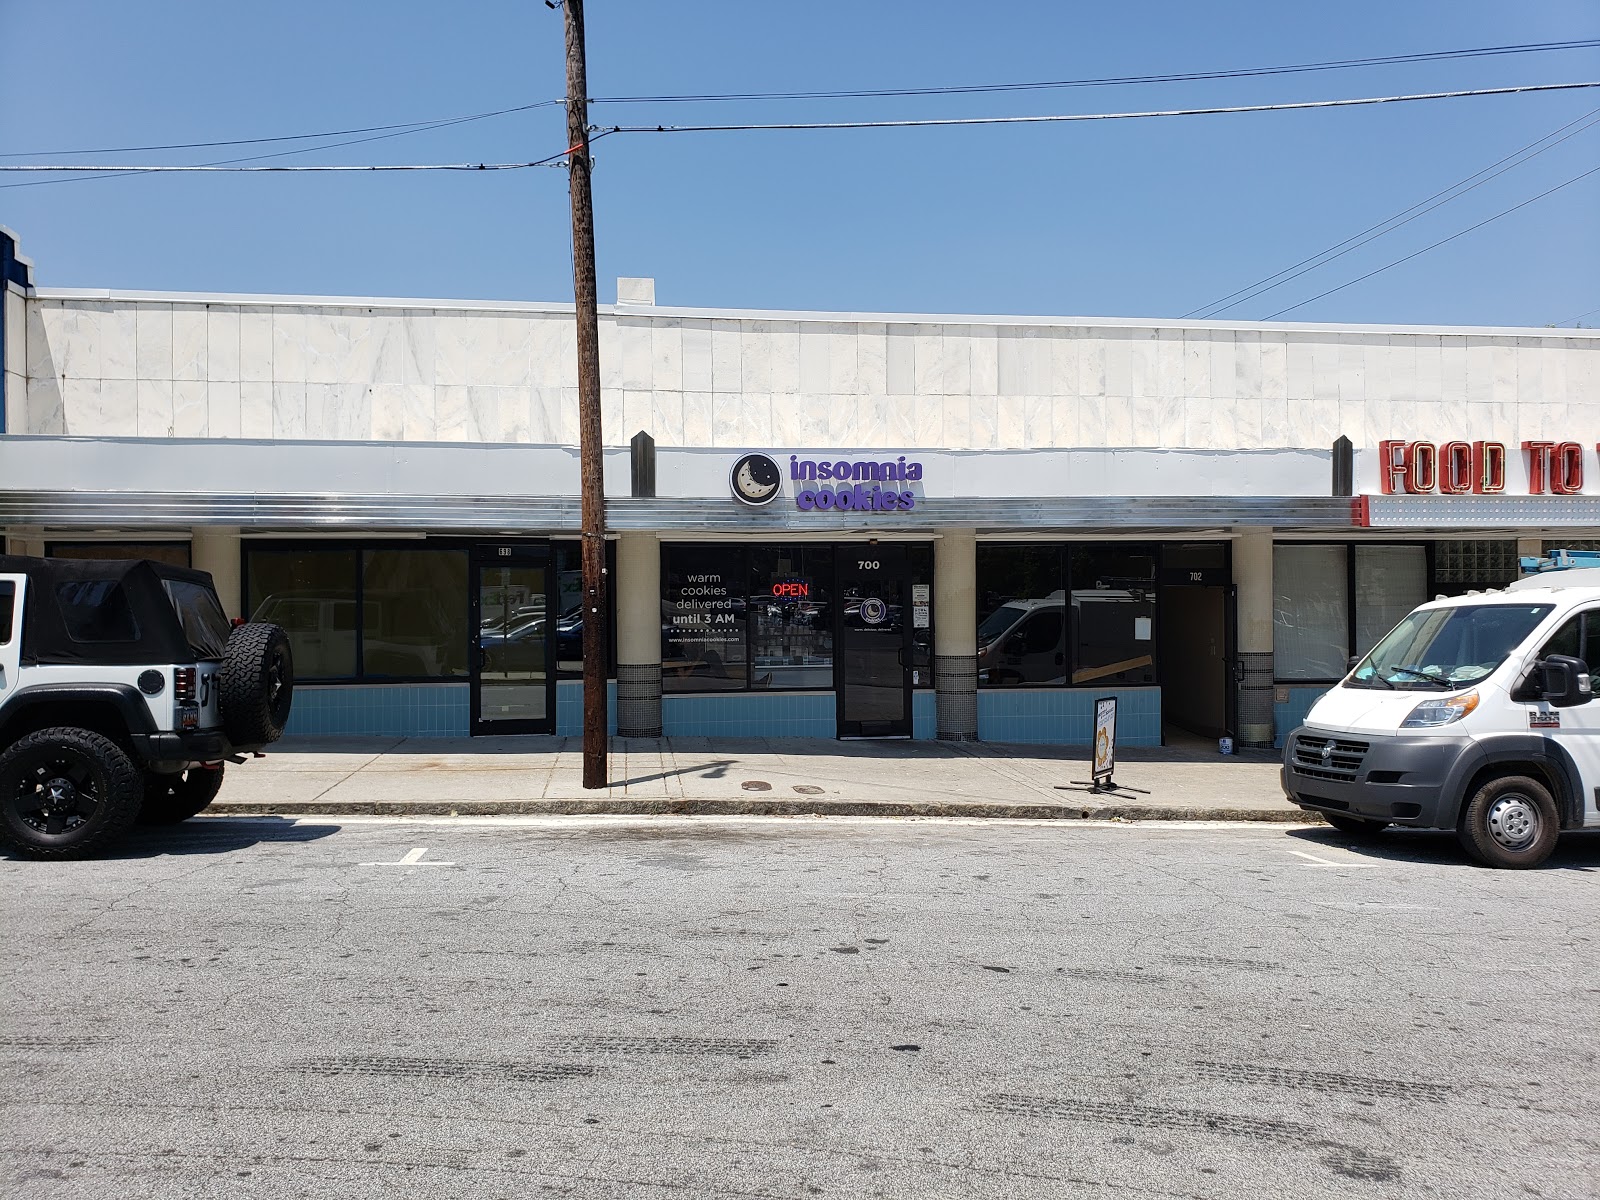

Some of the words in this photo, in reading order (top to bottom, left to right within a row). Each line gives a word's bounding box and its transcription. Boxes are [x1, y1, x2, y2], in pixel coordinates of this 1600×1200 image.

[790, 455, 923, 481] insomnia
[1379, 440, 1506, 495] FOOD
[796, 484, 915, 510] cookies
[857, 561, 880, 570] 700
[687, 574, 721, 583] warm
[1189, 572, 1202, 581] 702
[681, 585, 727, 596] cookies
[772, 583, 809, 596] OPEN
[676, 598, 732, 609] delivered
[672, 613, 700, 624] until
[704, 613, 712, 624] 3
[715, 613, 735, 624] AM
